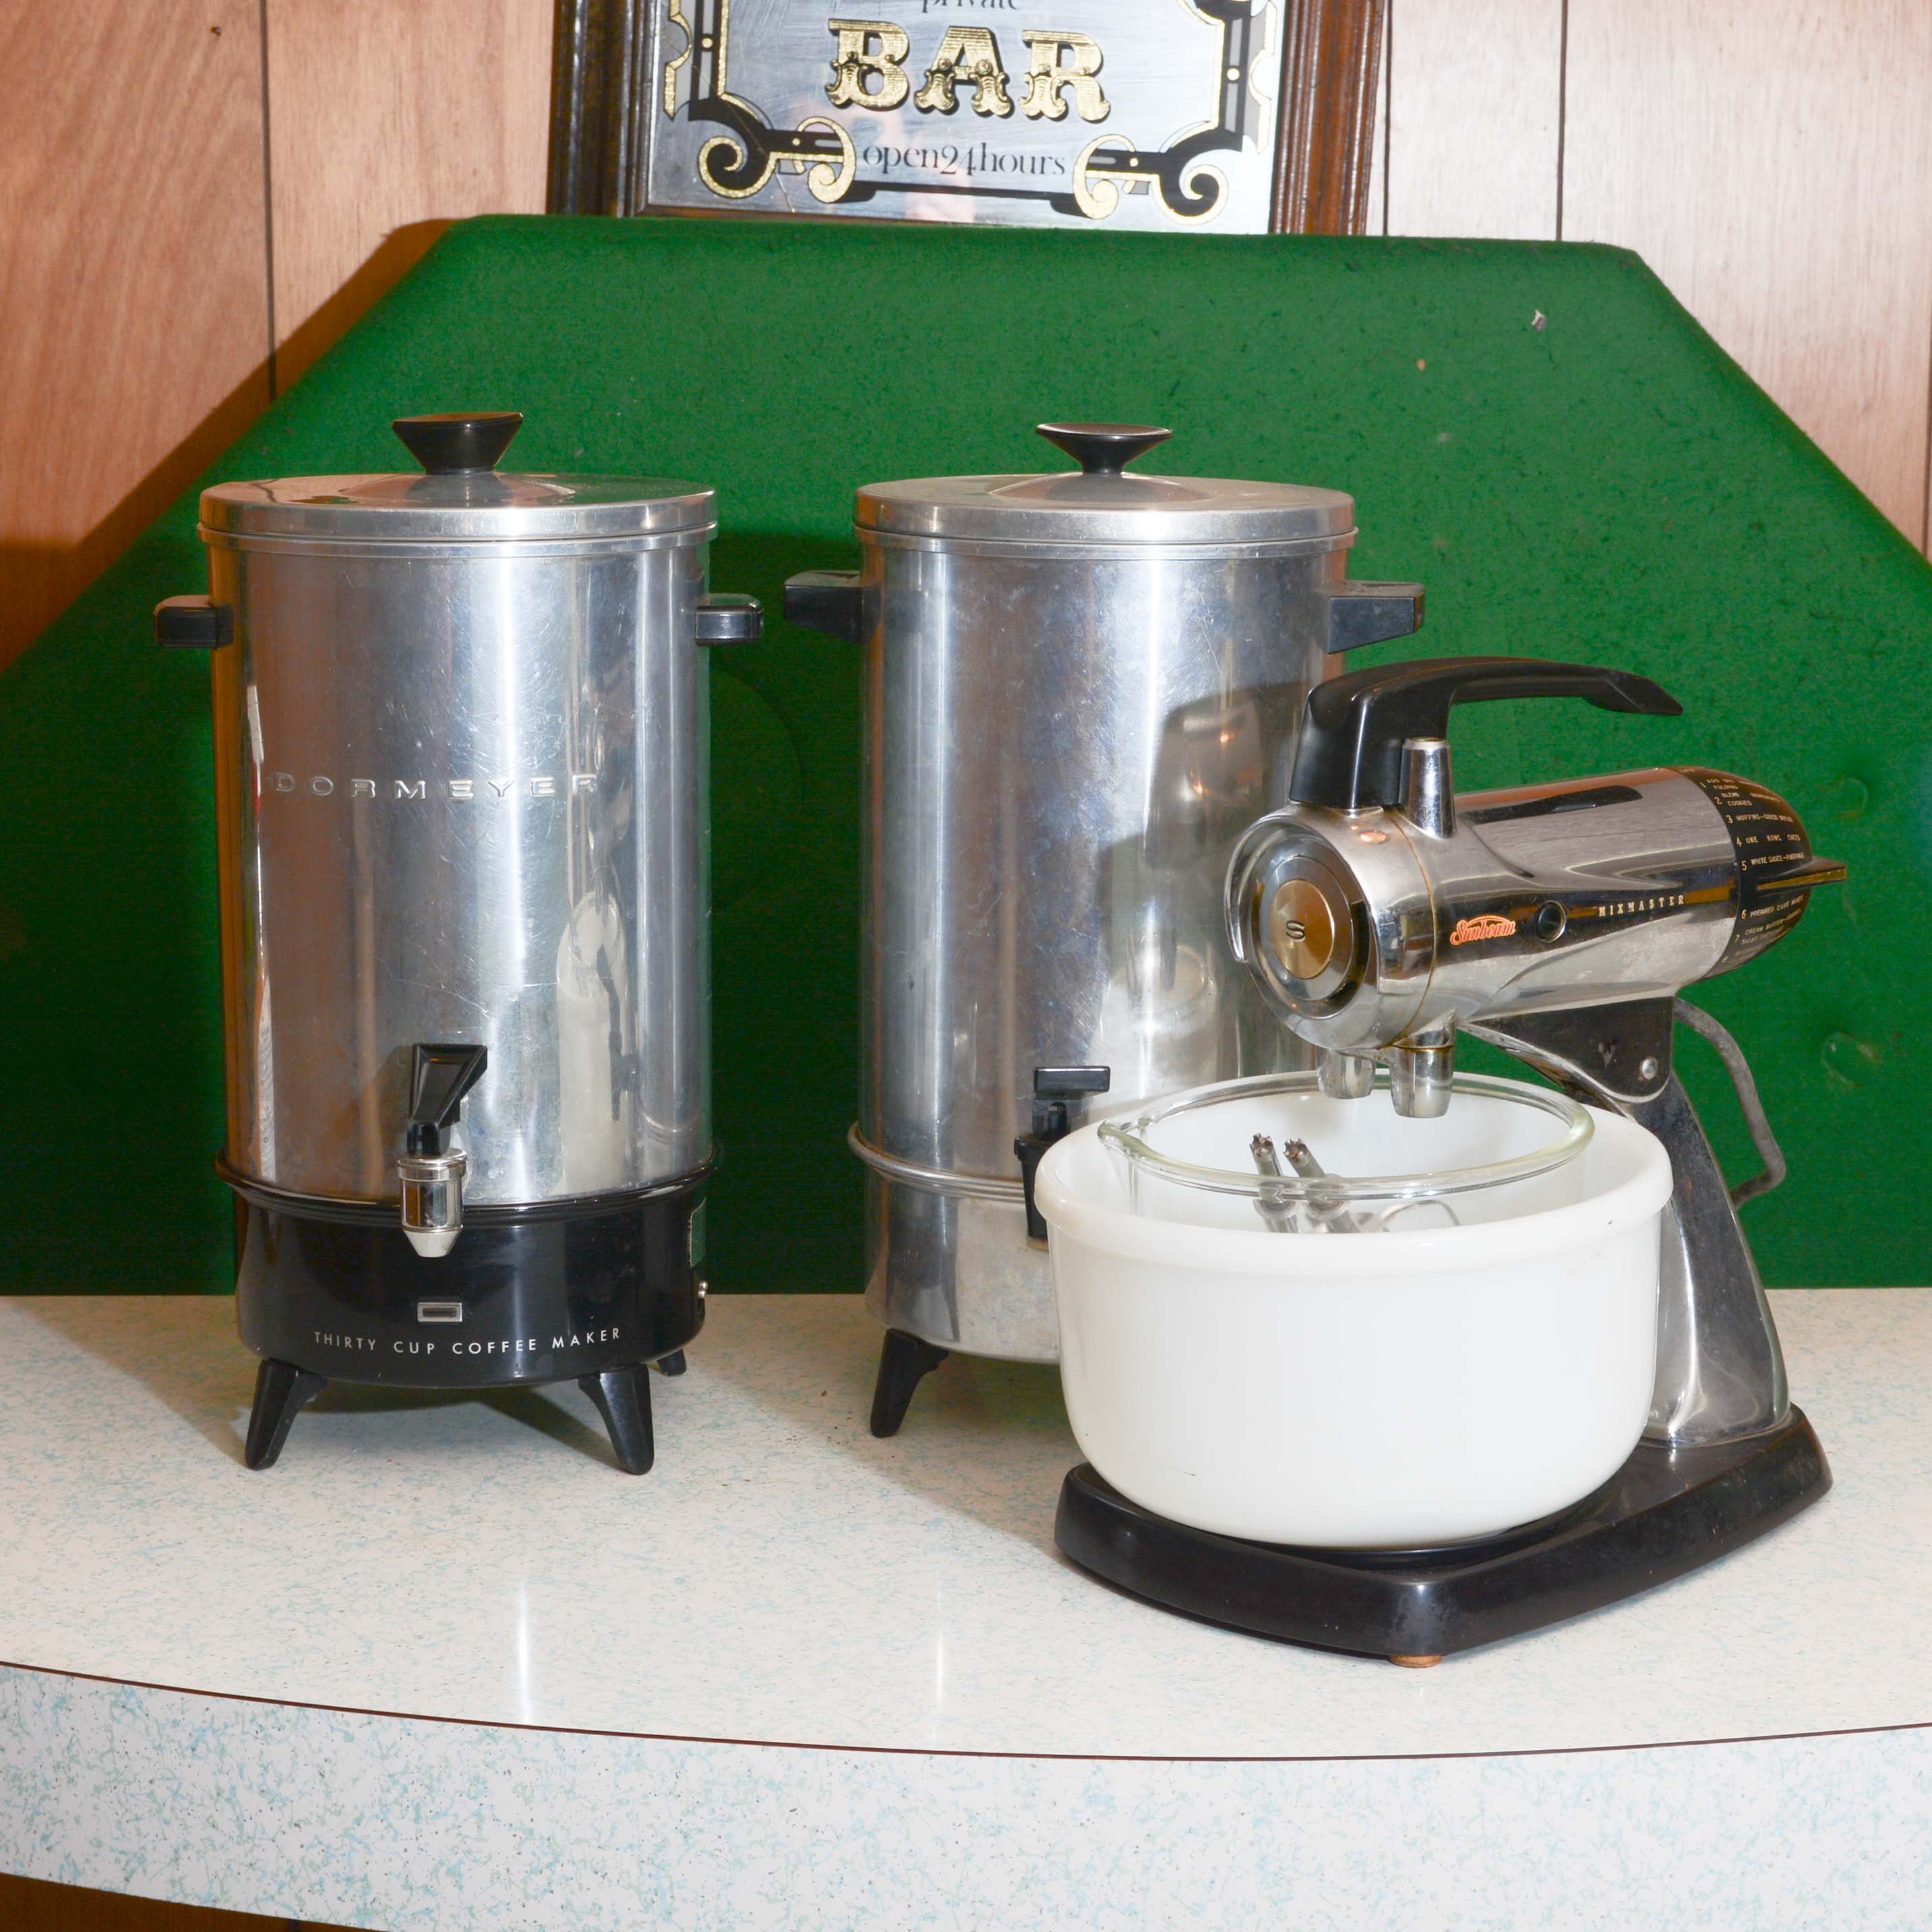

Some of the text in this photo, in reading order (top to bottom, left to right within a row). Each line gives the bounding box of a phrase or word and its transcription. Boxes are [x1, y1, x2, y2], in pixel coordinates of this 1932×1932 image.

[825, 18, 1111, 123] BAR
[272, 772, 598, 799] DORMEYER
[1714, 797, 1722, 805] 2
[1726, 814, 1733, 823] 3
[1736, 837, 1743, 847] 4
[1745, 836, 1759, 844] ONE
[1741, 860, 1747, 871] 5
[1751, 857, 1768, 865] WHITE
[1598, 895, 1684, 917] MIXMASTER
[1741, 909, 1747, 919] 6
[1286, 920, 1306, 941] S
[1450, 915, 1516, 945] Sunbeam
[314, 1327, 620, 1355] THIRTY CUP COFFEE MAKER
